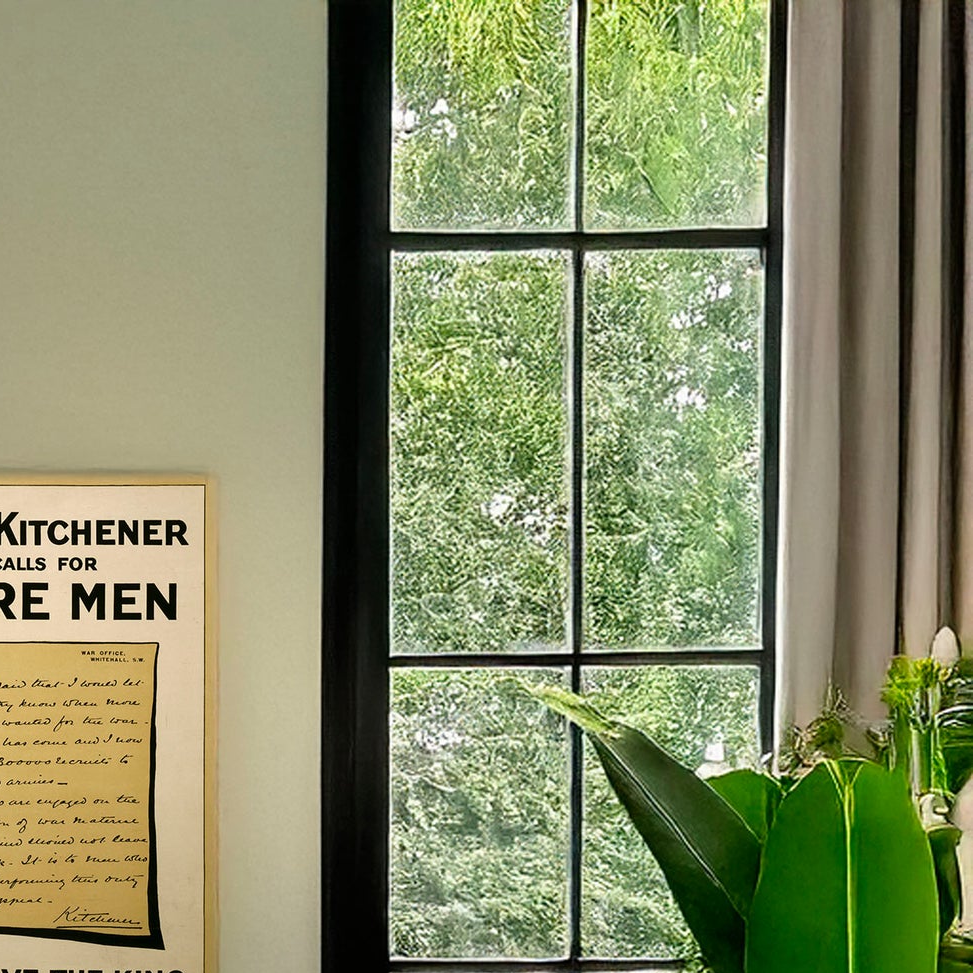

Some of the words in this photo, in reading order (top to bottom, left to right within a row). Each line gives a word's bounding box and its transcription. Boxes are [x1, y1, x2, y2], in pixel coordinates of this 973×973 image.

[58, 557, 97, 571] FOR
[71, 582, 177, 621] MEN
[31, 678, 64, 688] that
[68, 677, 78, 687] I
[80, 679, 117, 688] would
[122, 678, 144, 686] let
[19, 699, 56, 707] know
[63, 699, 98, 707] when
[2, 717, 51, 726] wanted
[53, 715, 73, 732] for
[83, 716, 103, 725] the
[3, 737, 27, 746] has
[75, 737, 100, 745] and
[103, 734, 113, 743] I
[120, 754, 134, 764] to
[36, 797, 87, 809] engaged
[116, 794, 140, 804] the
[16, 818, 28, 834] of
[72, 816, 140, 824] material
[80, 836, 106, 845] not
[112, 834, 148, 843] leave
[21, 854, 42, 865] It
[48, 852, 57, 864] is
[65, 854, 78, 864] to
[71, 874, 99, 883] this
[105, 874, 145, 889] duty
